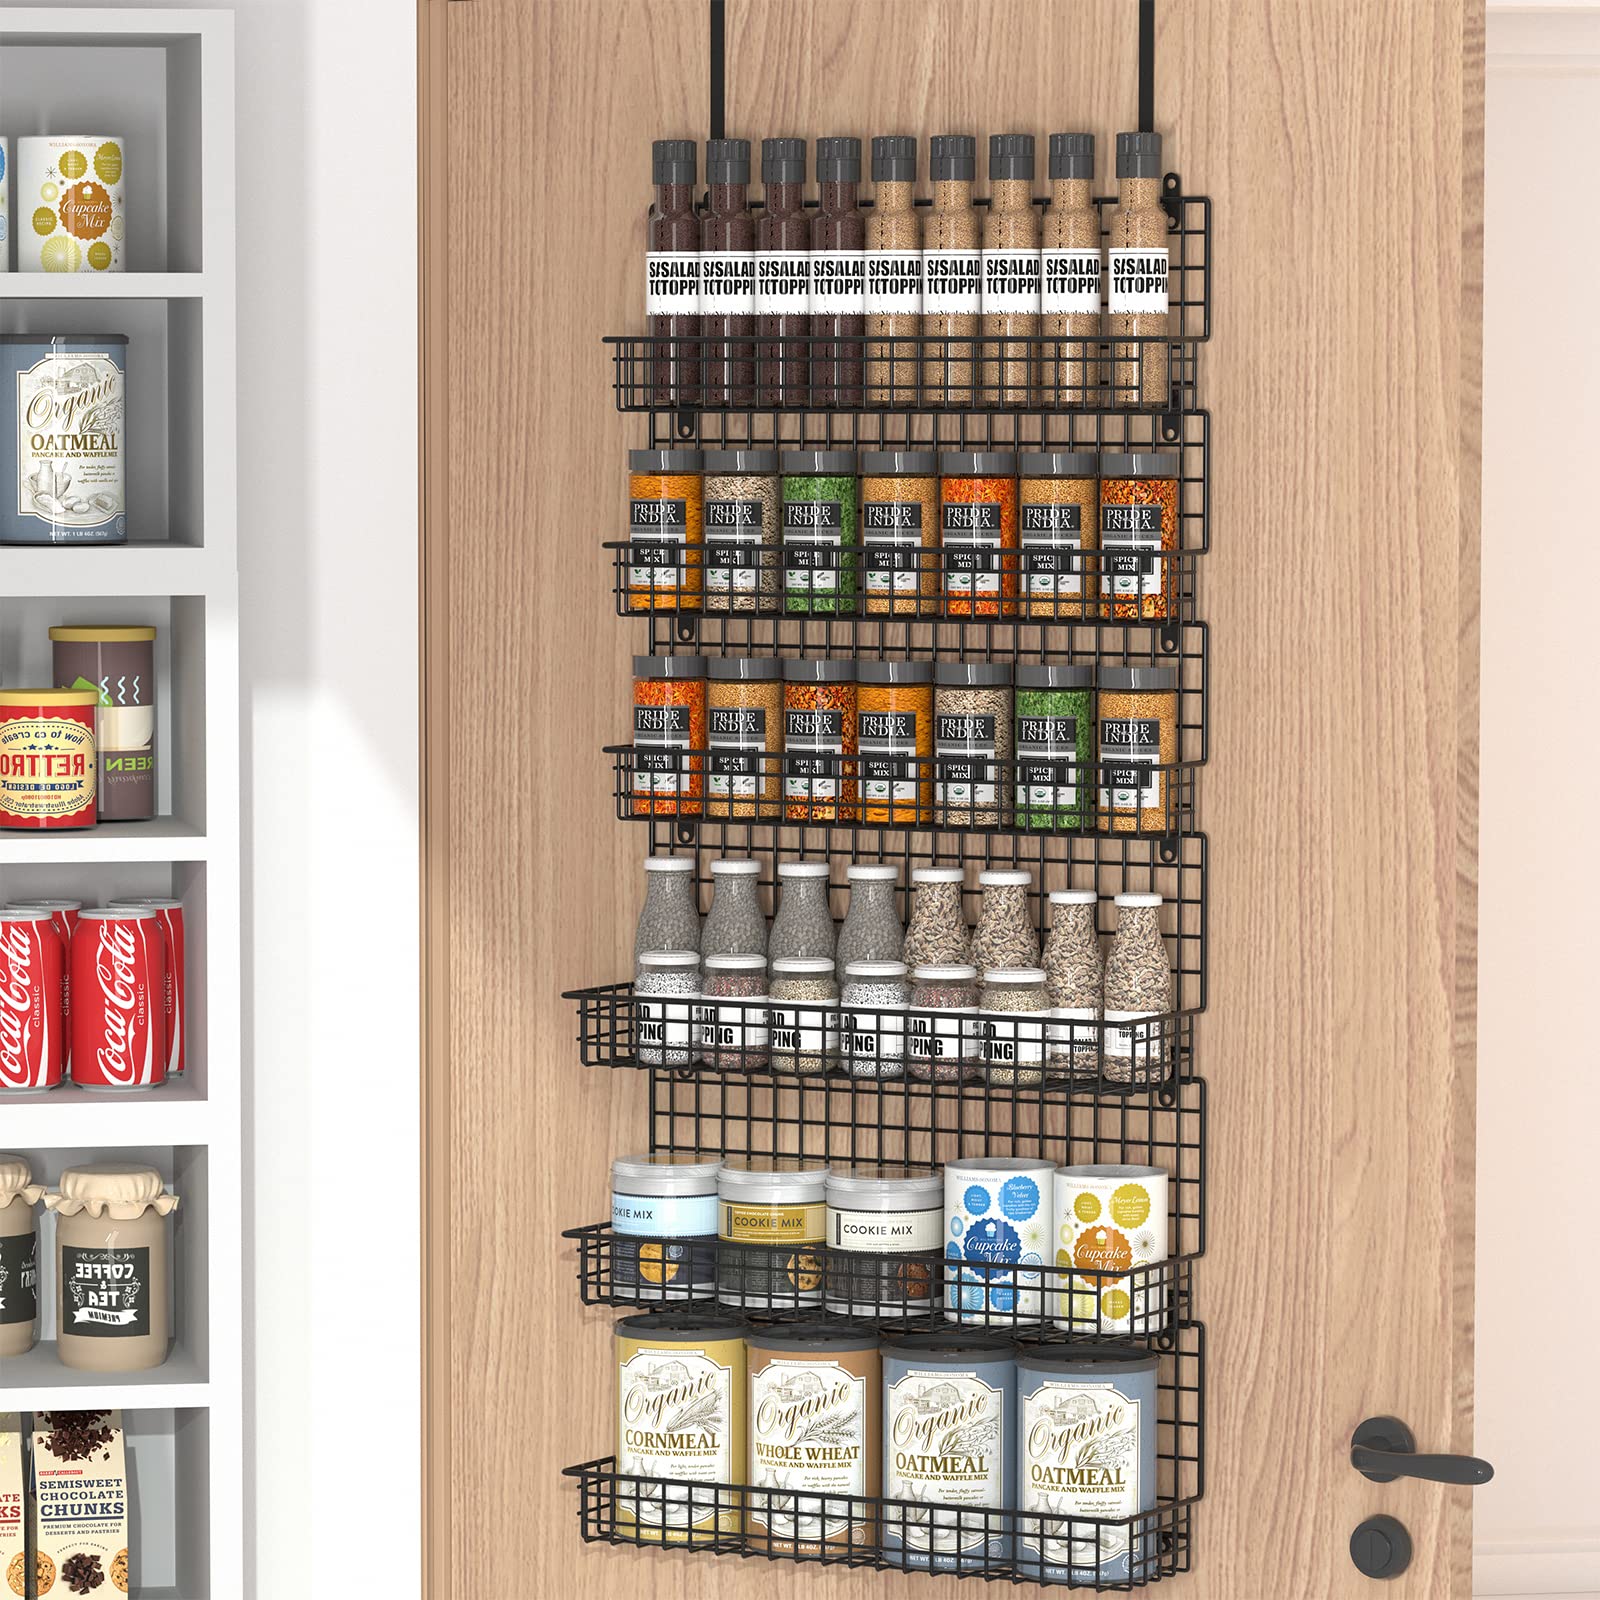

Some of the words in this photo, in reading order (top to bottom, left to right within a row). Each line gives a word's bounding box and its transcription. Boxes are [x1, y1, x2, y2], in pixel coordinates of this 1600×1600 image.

[62, 199, 110, 220] Cupcake
[77, 214, 106, 229] Mix
[26, 374, 116, 433] Organic
[31, 432, 118, 451] OATMEAL
[634, 504, 676, 514] PRIDE
[710, 504, 753, 515] PRIDE
[788, 506, 831, 516] PRIDE
[868, 506, 912, 517] PRIDE
[947, 508, 991, 518] PRIDE
[1026, 508, 1071, 519] PRIDE
[1107, 509, 1151, 520] PRIDE
[638, 710, 680, 720] PRIDE
[713, 712, 756, 722] PRIDE
[789, 714, 832, 725] PRIDE
[863, 716, 906, 727] PRIDE
[941, 718, 985, 729] PRIDE
[1022, 721, 1066, 732] PRIDE
[1105, 723, 1150, 734] PRIDE
[634, 1210, 653, 1220] MIX
[734, 1217, 778, 1228] COOKIE
[782, 1218, 803, 1228] MIX
[843, 1224, 887, 1235] COOKIE
[891, 1226, 913, 1235] MIX
[966, 1237, 1017, 1254] Cupcake
[1076, 1245, 1128, 1261] Cupcake
[624, 1370, 716, 1428] Organic
[757, 1381, 848, 1441] Organic
[893, 1393, 987, 1453] Organic
[626, 1429, 721, 1449] CORNMEAL
[1028, 1404, 1123, 1465] Organic
[628, 1447, 654, 1456] PANCAKE
[756, 1442, 802, 1460] WHOLE
[805, 1446, 860, 1461] WHEAT
[760, 1458, 788, 1468] PANCAKE
[896, 1452, 989, 1474] OATMEAL
[896, 1471, 924, 1480] PANCAKE
[1032, 1464, 1126, 1485] OATMEAL
[40, 1479, 123, 1490] SEMISWEET
[1032, 1483, 1060, 1492] PANCAKE
[40, 1490, 124, 1502] CHOCOLATE
[40, 1502, 124, 1517] CHUNKS
